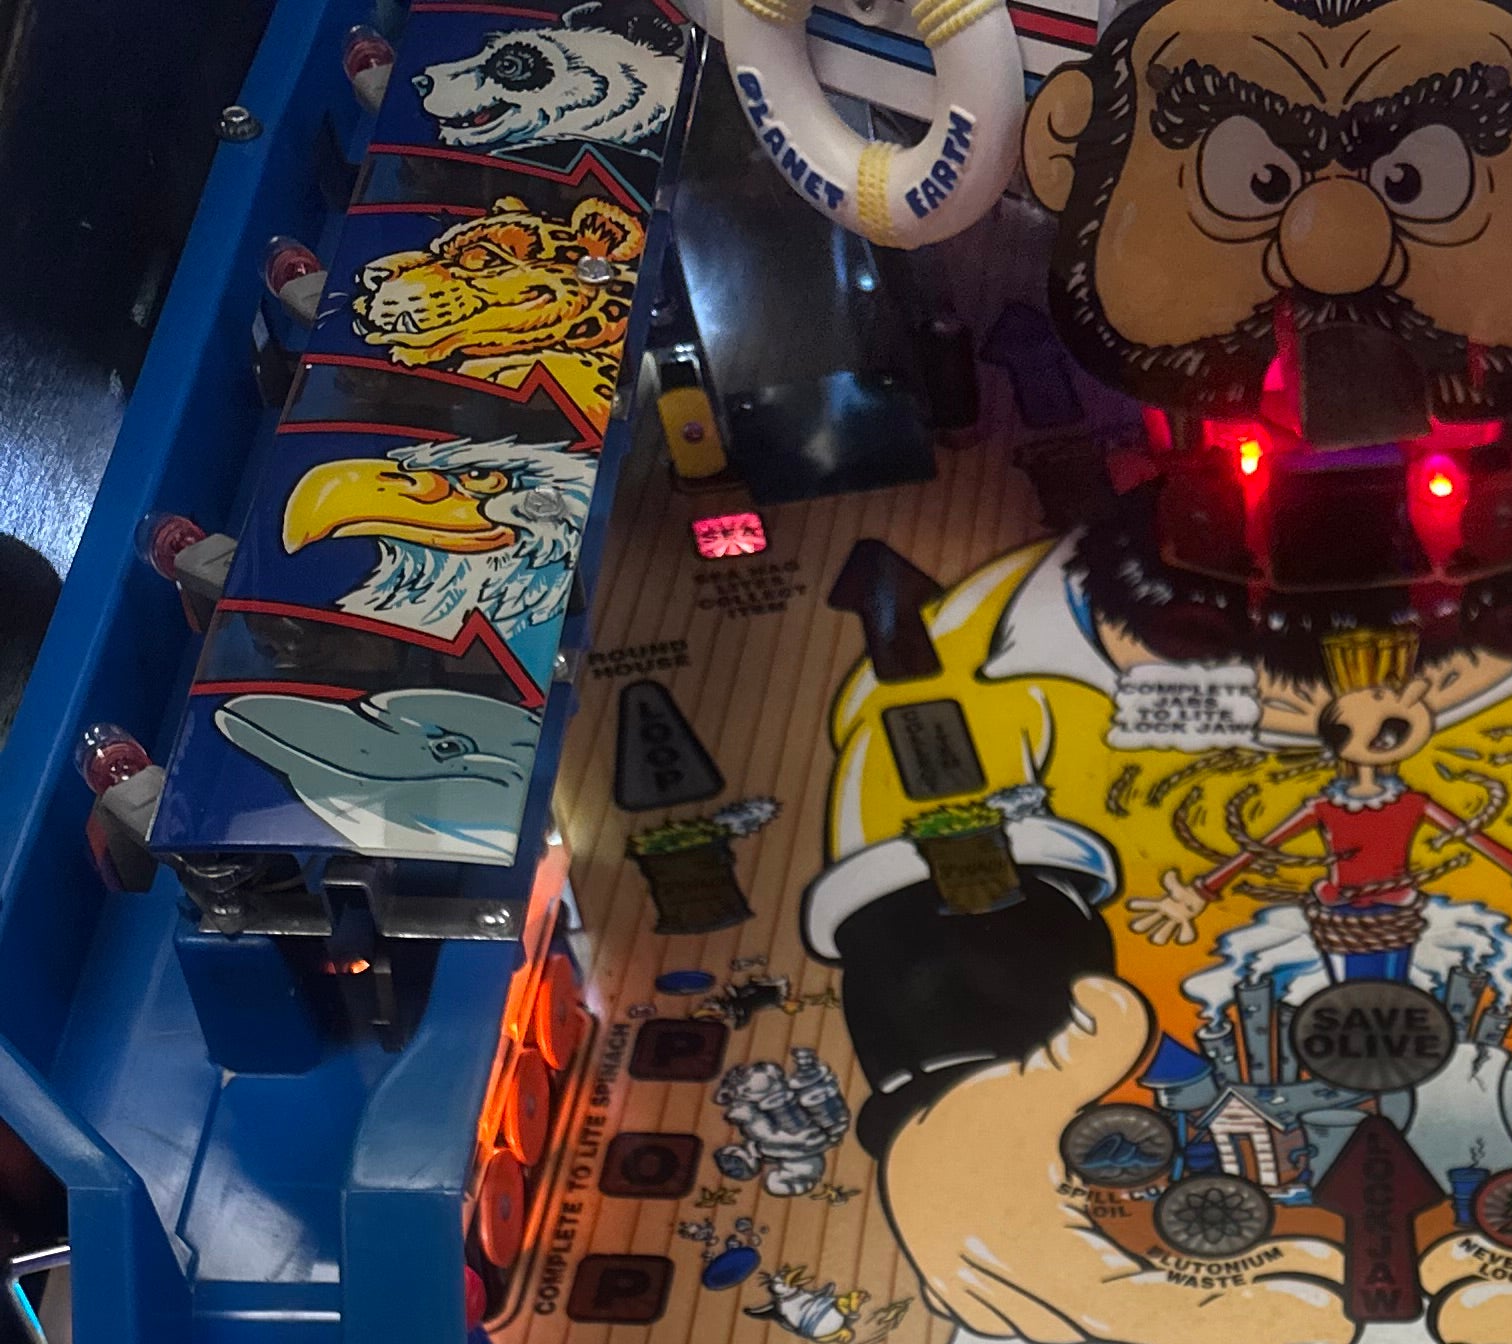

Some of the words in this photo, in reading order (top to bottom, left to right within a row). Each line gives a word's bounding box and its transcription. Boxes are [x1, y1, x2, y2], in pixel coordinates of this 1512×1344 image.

[736, 71, 845, 210] PLANET
[905, 110, 975, 219] EARTH
[587, 640, 688, 665] ROUND
[592, 654, 692, 678] HOUSE
[1116, 682, 1257, 696] COMPLETE
[1119, 723, 1187, 734] LOCK
[1138, 710, 1173, 722] TO
[1180, 709, 1237, 722] LITE
[637, 701, 684, 793] LOOP
[1312, 1007, 1431, 1033] SAVE
[1302, 1033, 1442, 1060] OLIVE
[591, 1022, 632, 1109] SPINACH
[582, 1113, 609, 1162] LITE
[568, 1164, 592, 1193] TO
[533, 1201, 583, 1317] COMPLETE
[1146, 1244, 1284, 1276] PLUTONIUM
[1165, 1269, 1248, 1290] WASTE
